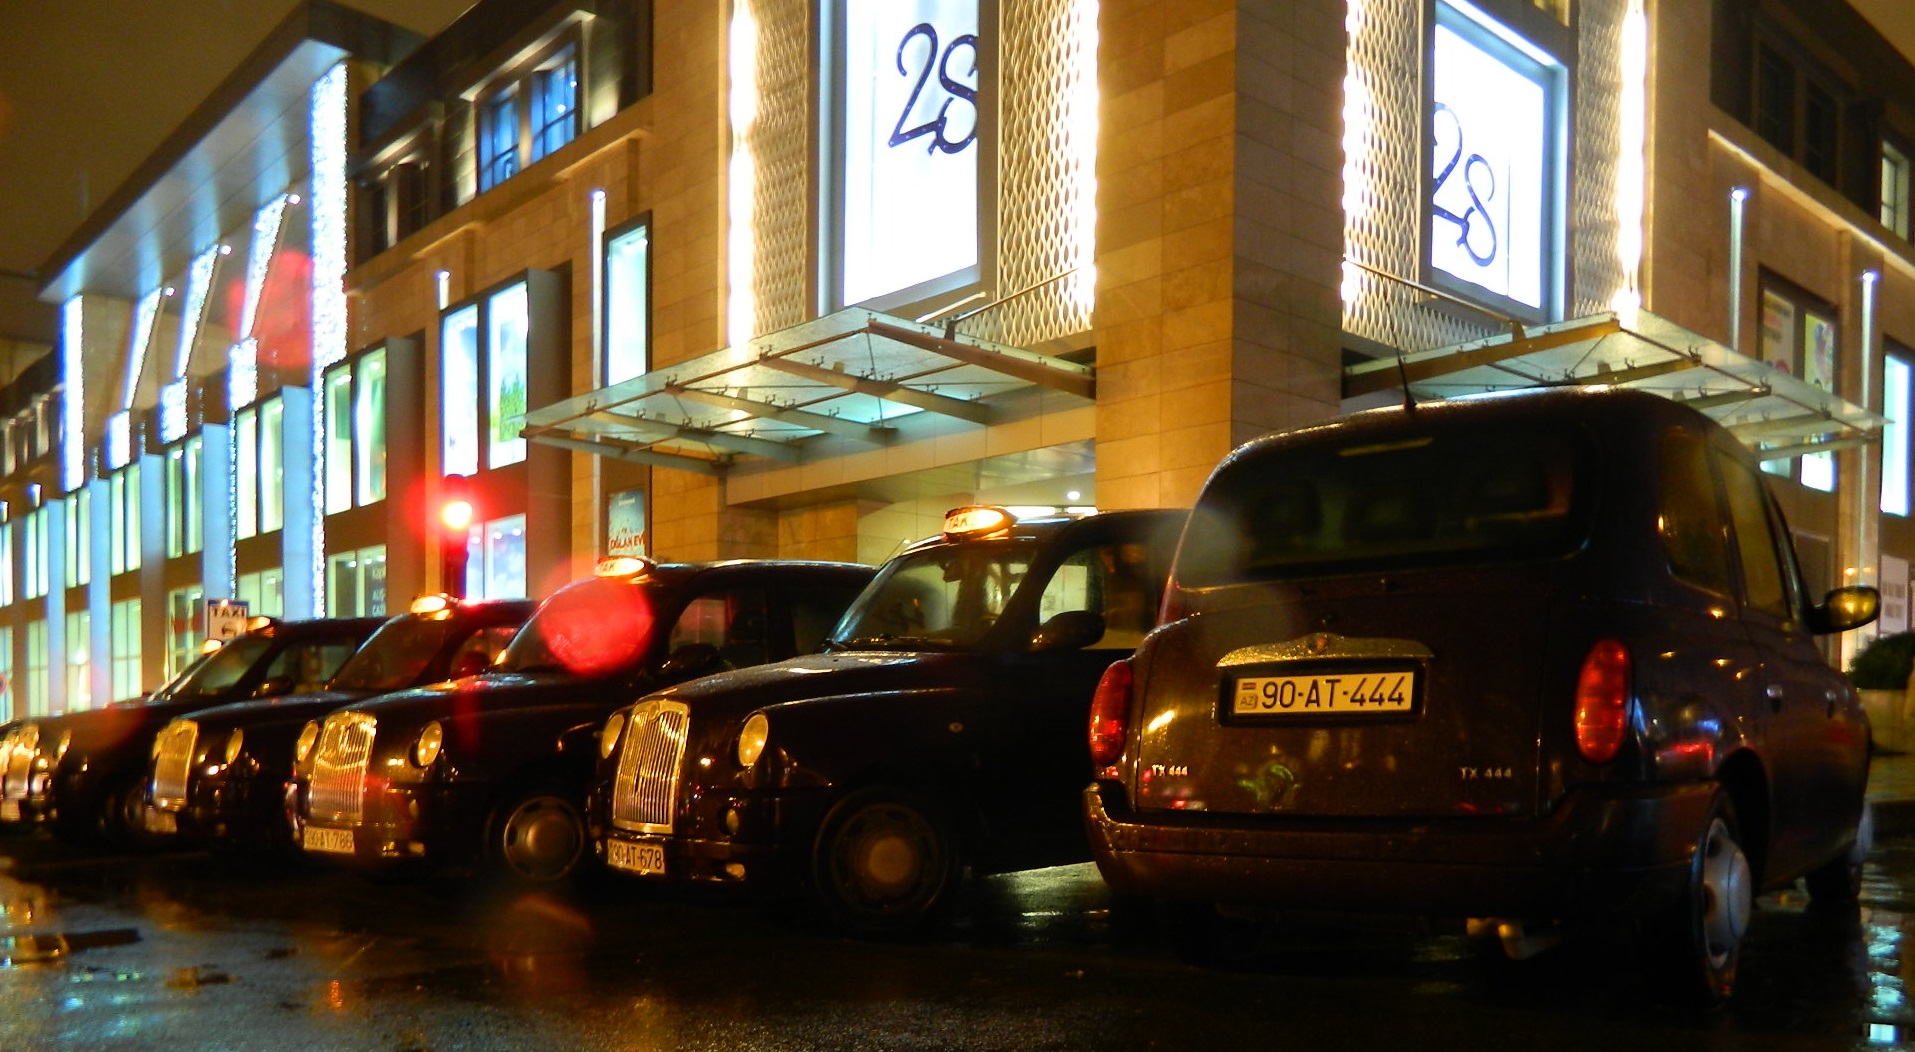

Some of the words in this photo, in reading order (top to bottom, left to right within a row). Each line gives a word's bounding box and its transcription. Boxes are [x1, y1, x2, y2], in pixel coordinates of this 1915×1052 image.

[213, 607, 246, 618] TAXI
[1261, 676, 1405, 709] 90-AT-444
[1240, 695, 1255, 706] AZ
[1151, 763, 1166, 777] TX
[1168, 765, 1188, 777] 444
[1459, 766, 1478, 779] TX
[1484, 767, 1513, 779] 444
[613, 842, 662, 870] 90-AT-678
